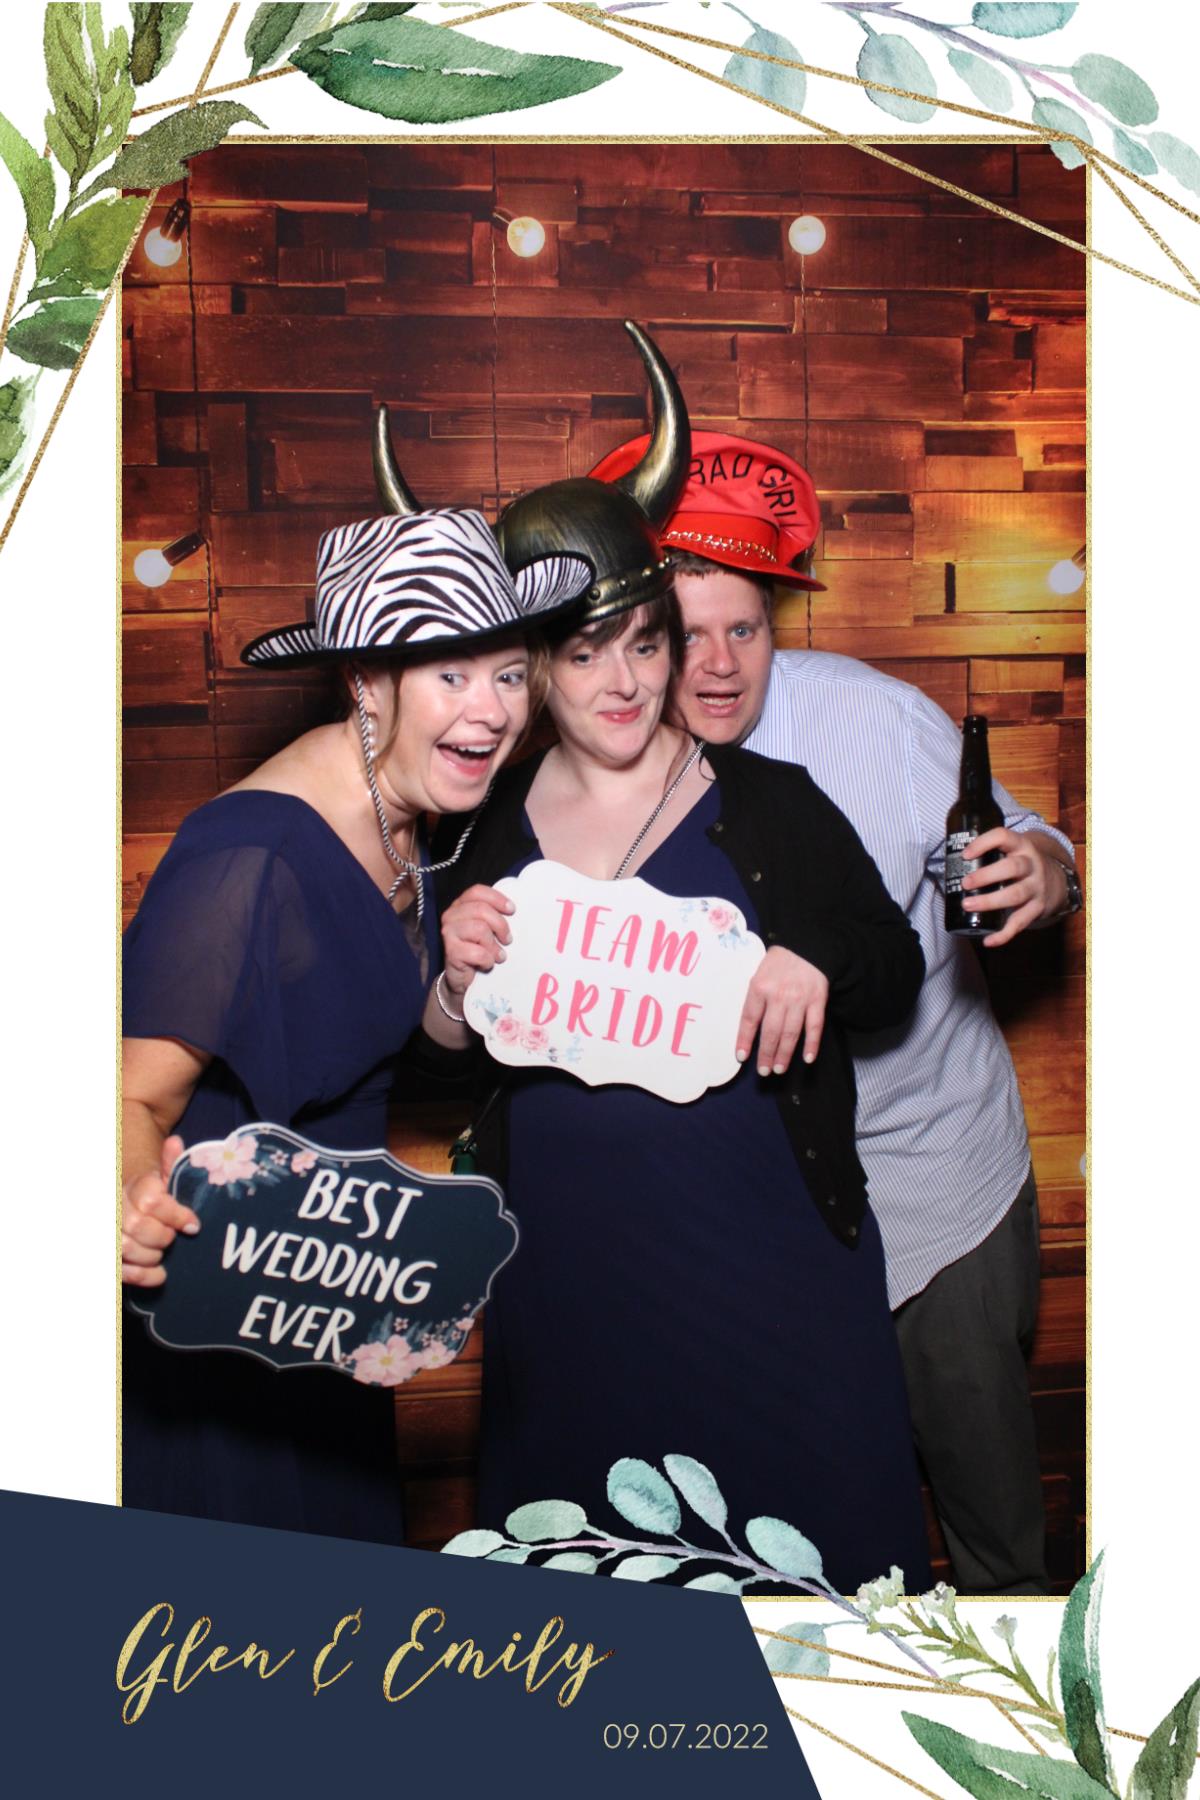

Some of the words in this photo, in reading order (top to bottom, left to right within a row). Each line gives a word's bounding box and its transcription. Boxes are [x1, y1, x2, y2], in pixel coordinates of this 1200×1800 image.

[688, 453, 754, 486] BAD
[556, 898, 702, 977] TEAM
[530, 972, 703, 1057] BRIDE
[297, 1168, 424, 1240] BEST
[221, 1222, 438, 1305] WEDDING
[238, 1294, 356, 1363] EVER
